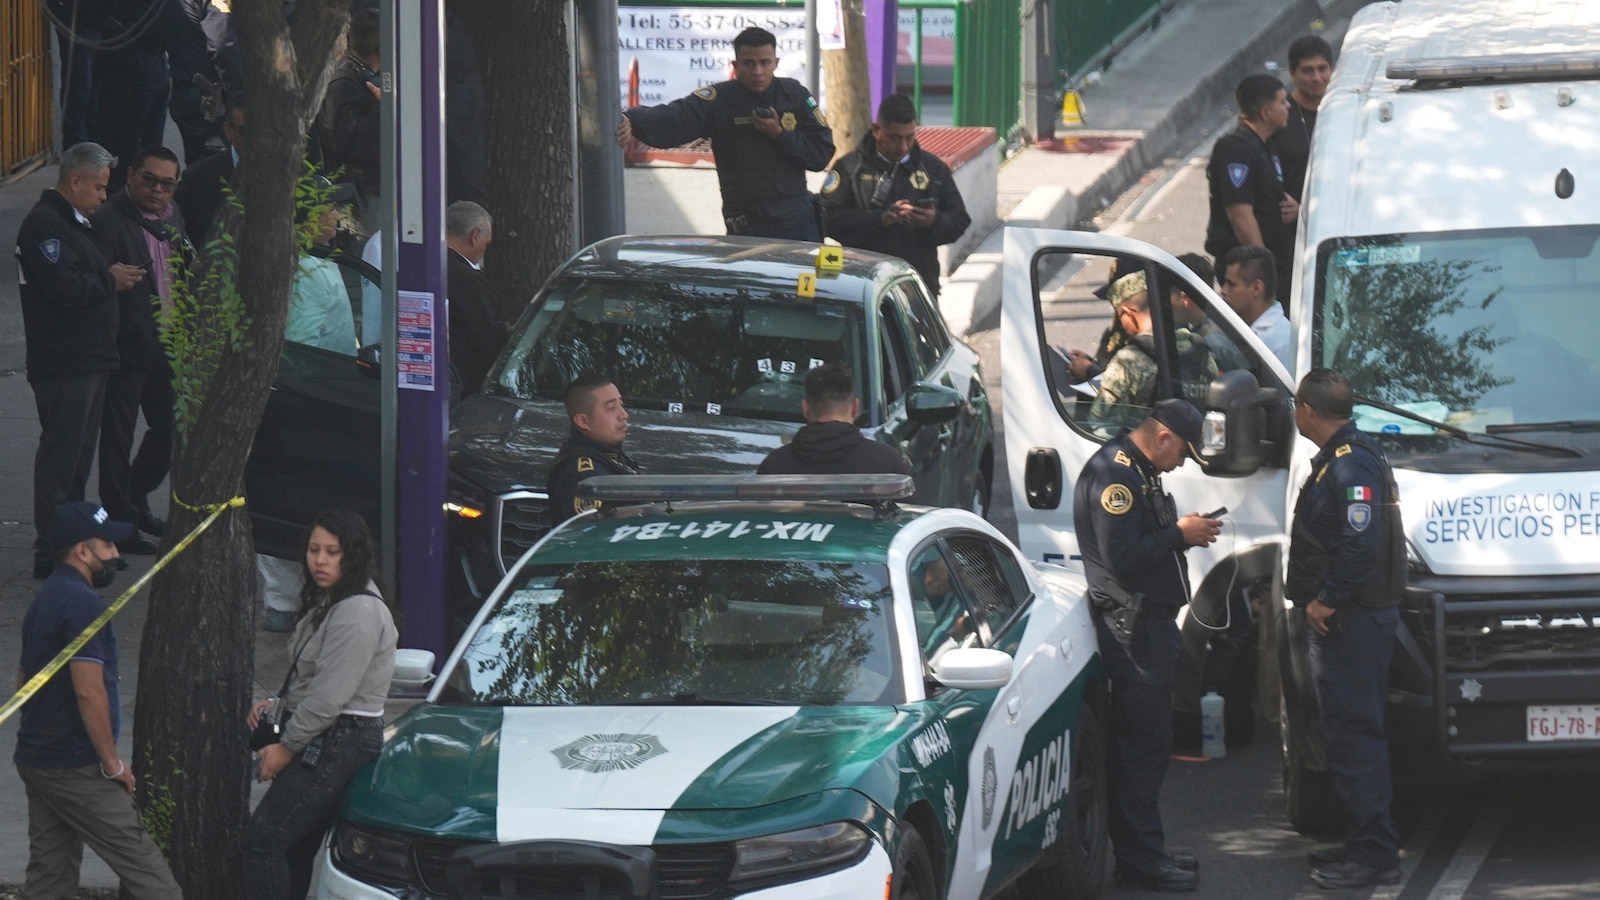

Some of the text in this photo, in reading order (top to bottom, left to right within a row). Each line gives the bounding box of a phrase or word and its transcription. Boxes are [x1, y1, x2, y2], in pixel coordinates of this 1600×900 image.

[628, 13, 661, 29] Tel:
[618, 37, 685, 49] ALLERES
[803, 276, 810, 292] 7
[760, 360, 770, 371] 4
[782, 363, 793, 372] 3
[671, 404, 718, 413] 6 5
[1425, 489, 1582, 518] INVESTIGACIÓN
[609, 521, 834, 542] MX-141-B4
[1425, 515, 1553, 544] SERVICIOS
[1501, 612, 1600, 629] RA
[1005, 729, 1071, 840] POLICIA
